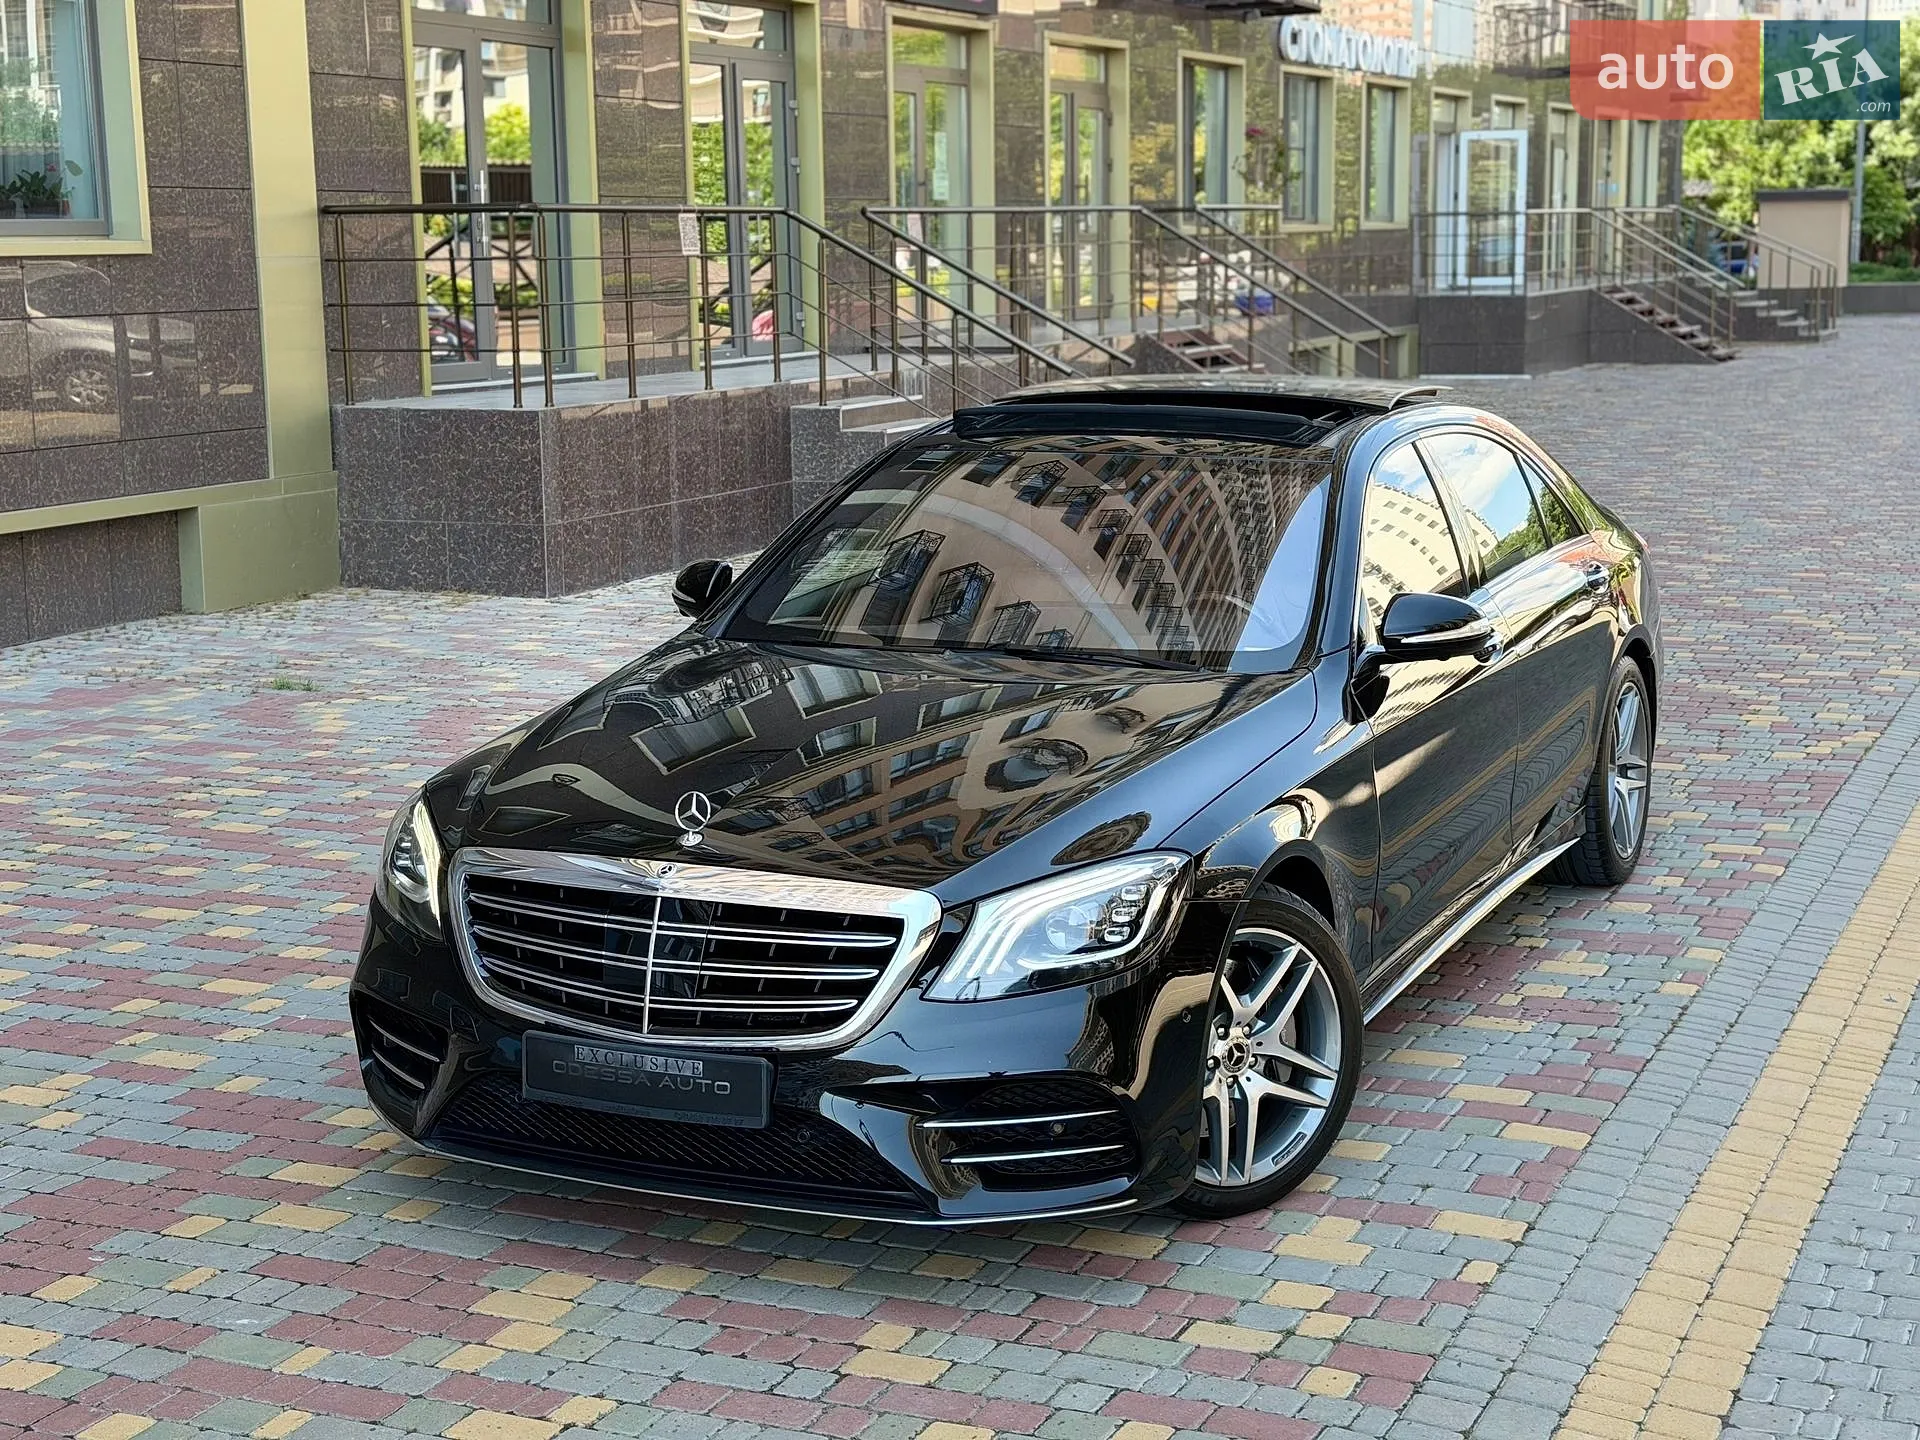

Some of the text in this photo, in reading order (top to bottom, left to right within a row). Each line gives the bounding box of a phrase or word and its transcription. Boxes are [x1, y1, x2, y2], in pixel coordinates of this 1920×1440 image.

[1280, 15, 1418, 79] СТОМАТОЛОГИЯ
[552, 1059, 731, 1095] ODESSA AUTO
[575, 1045, 702, 1076] EXCLUSIVE
